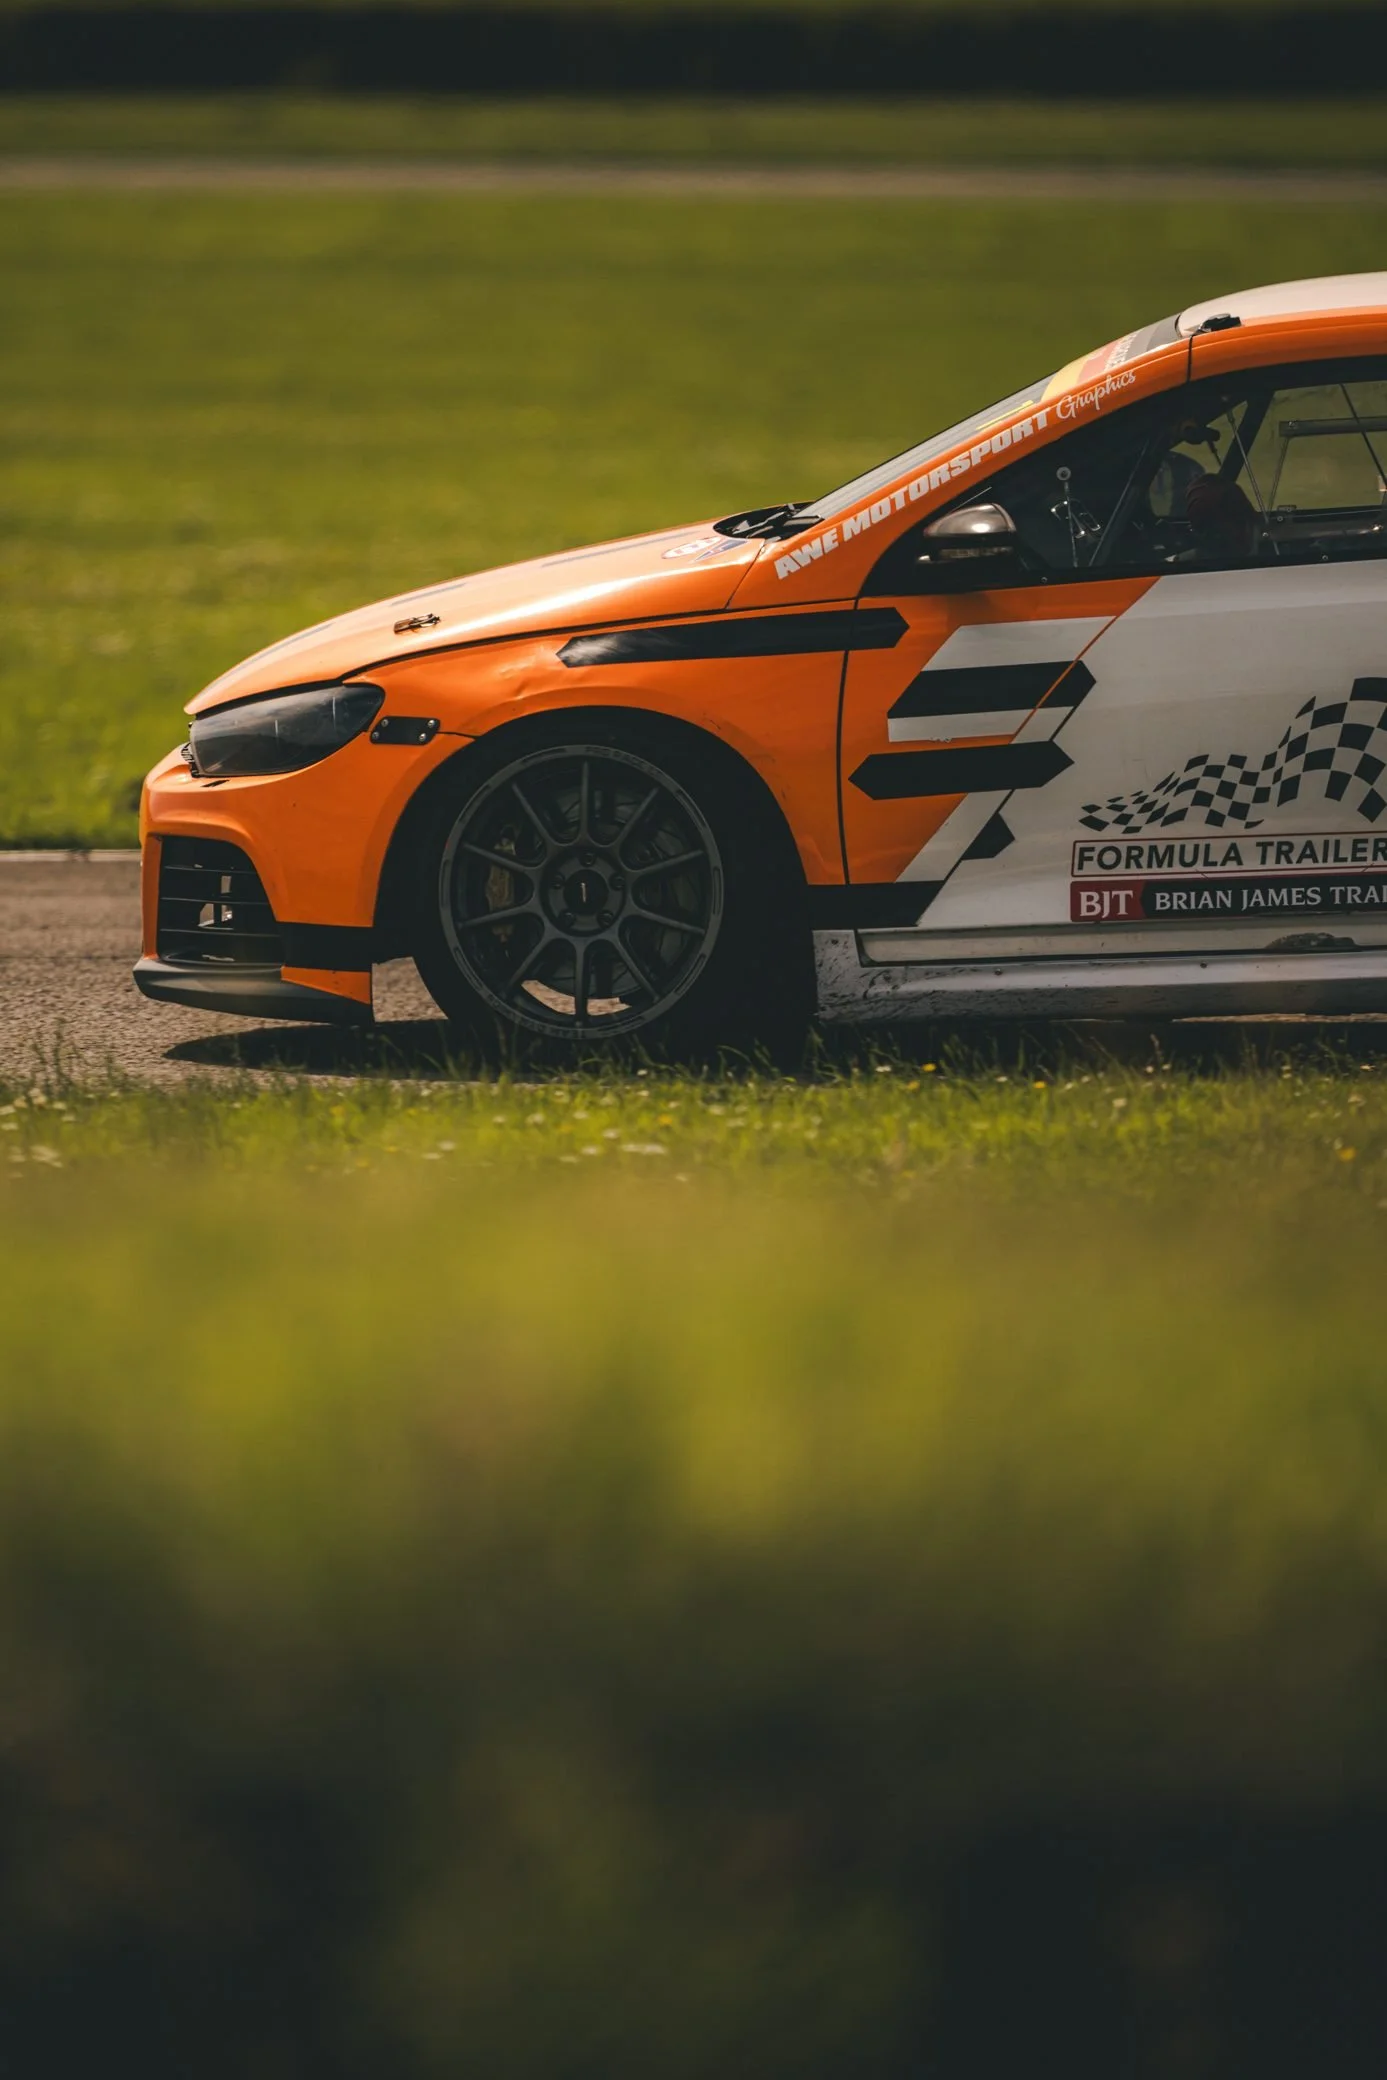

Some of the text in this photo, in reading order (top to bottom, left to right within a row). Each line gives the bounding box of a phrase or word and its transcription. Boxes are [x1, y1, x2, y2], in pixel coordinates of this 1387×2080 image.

[774, 528, 839, 579] AWE
[842, 407, 1050, 541] MOTORSPORT
[1055, 370, 1136, 419] Graphics
[1077, 842, 1244, 870] FORMULA
[1079, 889, 1134, 918] BJT
[1155, 889, 1233, 911] BRIAN
[1241, 886, 1321, 910] JAMES
